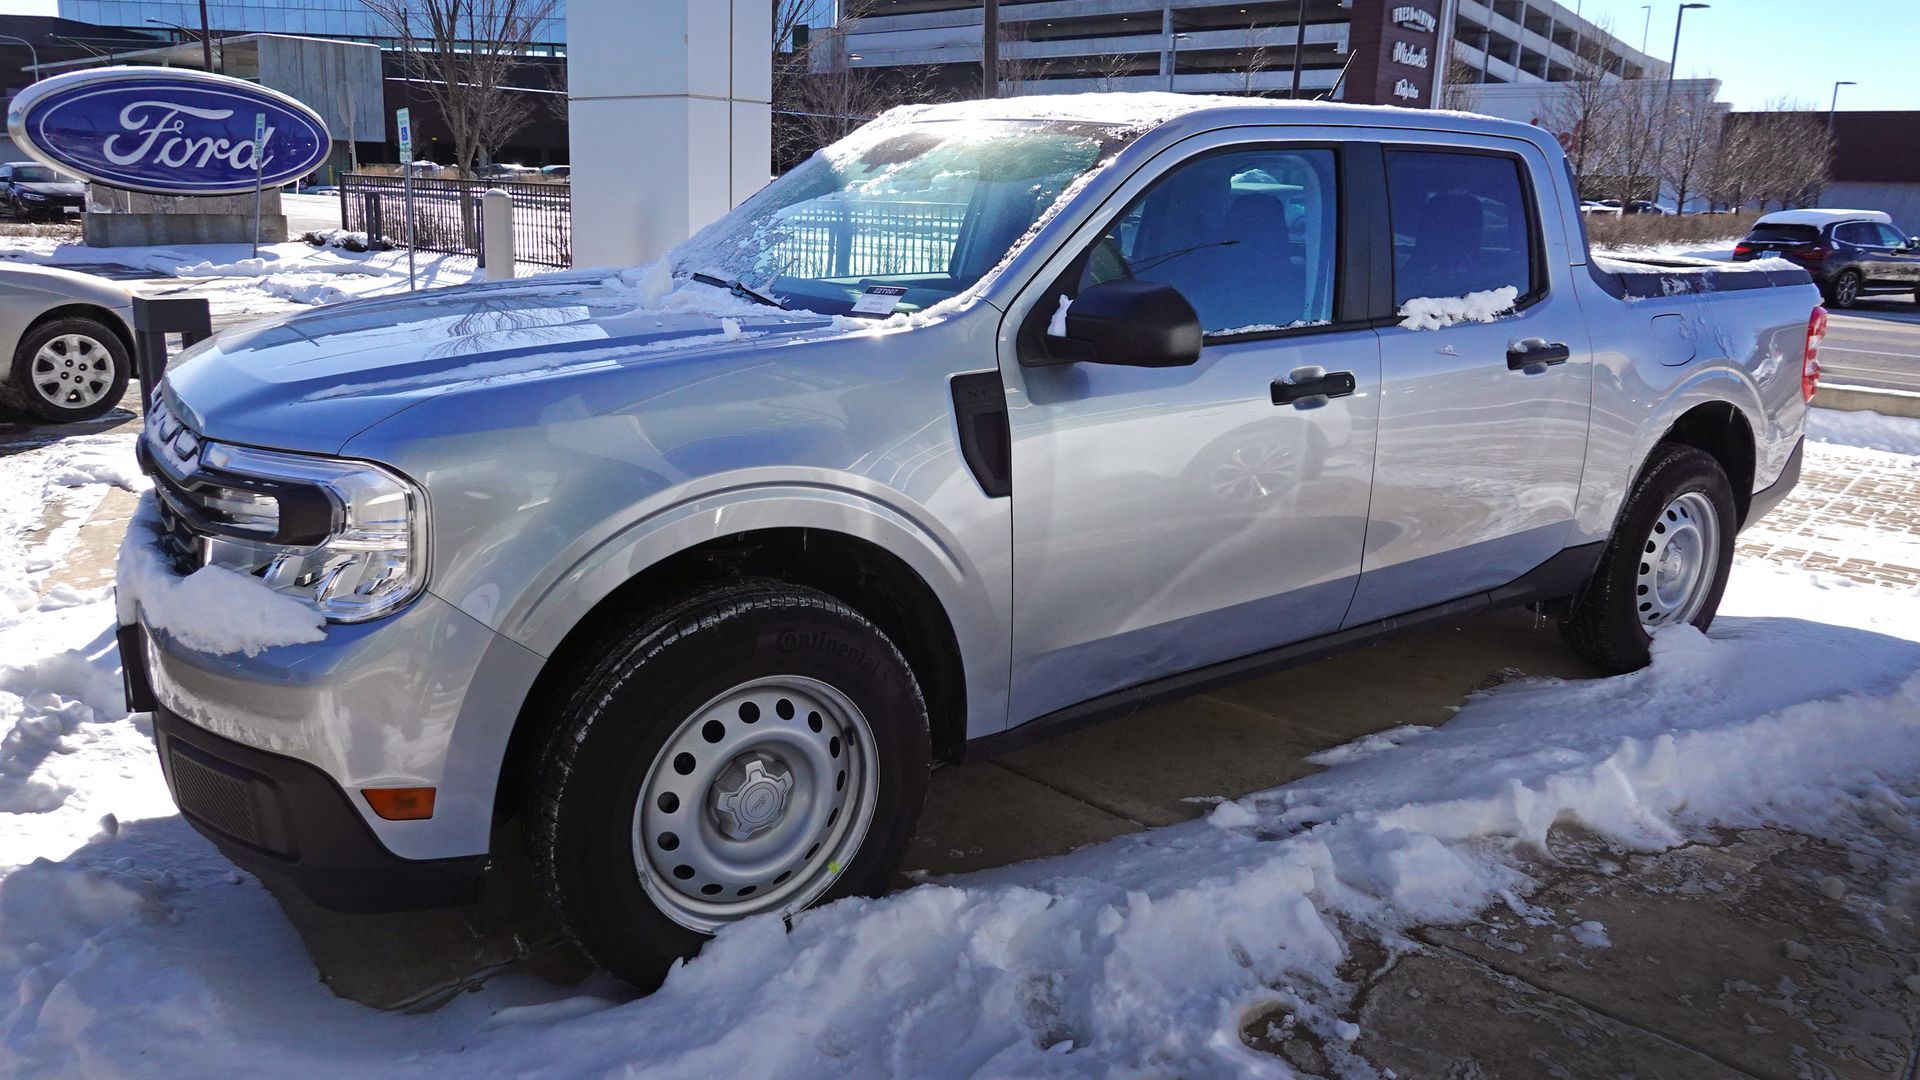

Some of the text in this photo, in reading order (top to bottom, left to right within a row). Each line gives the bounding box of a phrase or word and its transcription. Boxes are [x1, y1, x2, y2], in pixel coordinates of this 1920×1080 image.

[1393, 41, 1427, 68] Michaels
[103, 100, 276, 170] Ford
[777, 631, 881, 676] Continental
